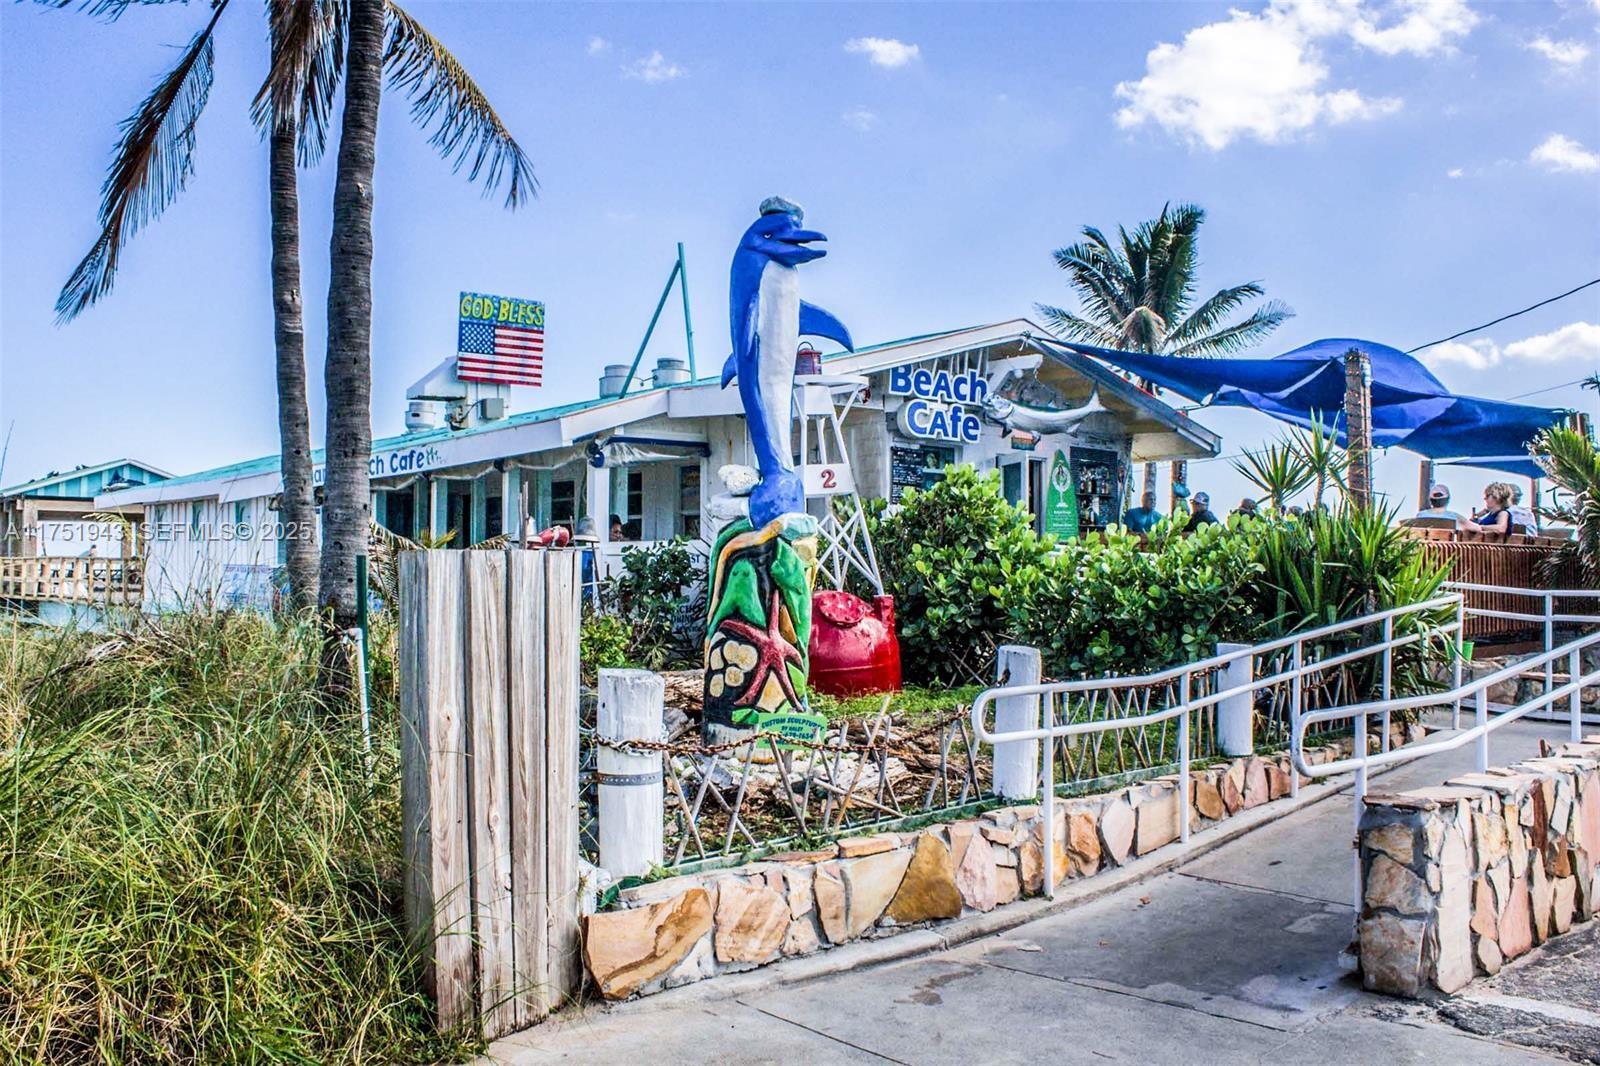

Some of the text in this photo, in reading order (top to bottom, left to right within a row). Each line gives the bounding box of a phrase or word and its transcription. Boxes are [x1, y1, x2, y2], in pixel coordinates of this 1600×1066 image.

[461, 295, 544, 326] GOD BLESS
[389, 449, 425, 474] Cafe
[821, 469, 837, 488] 2
